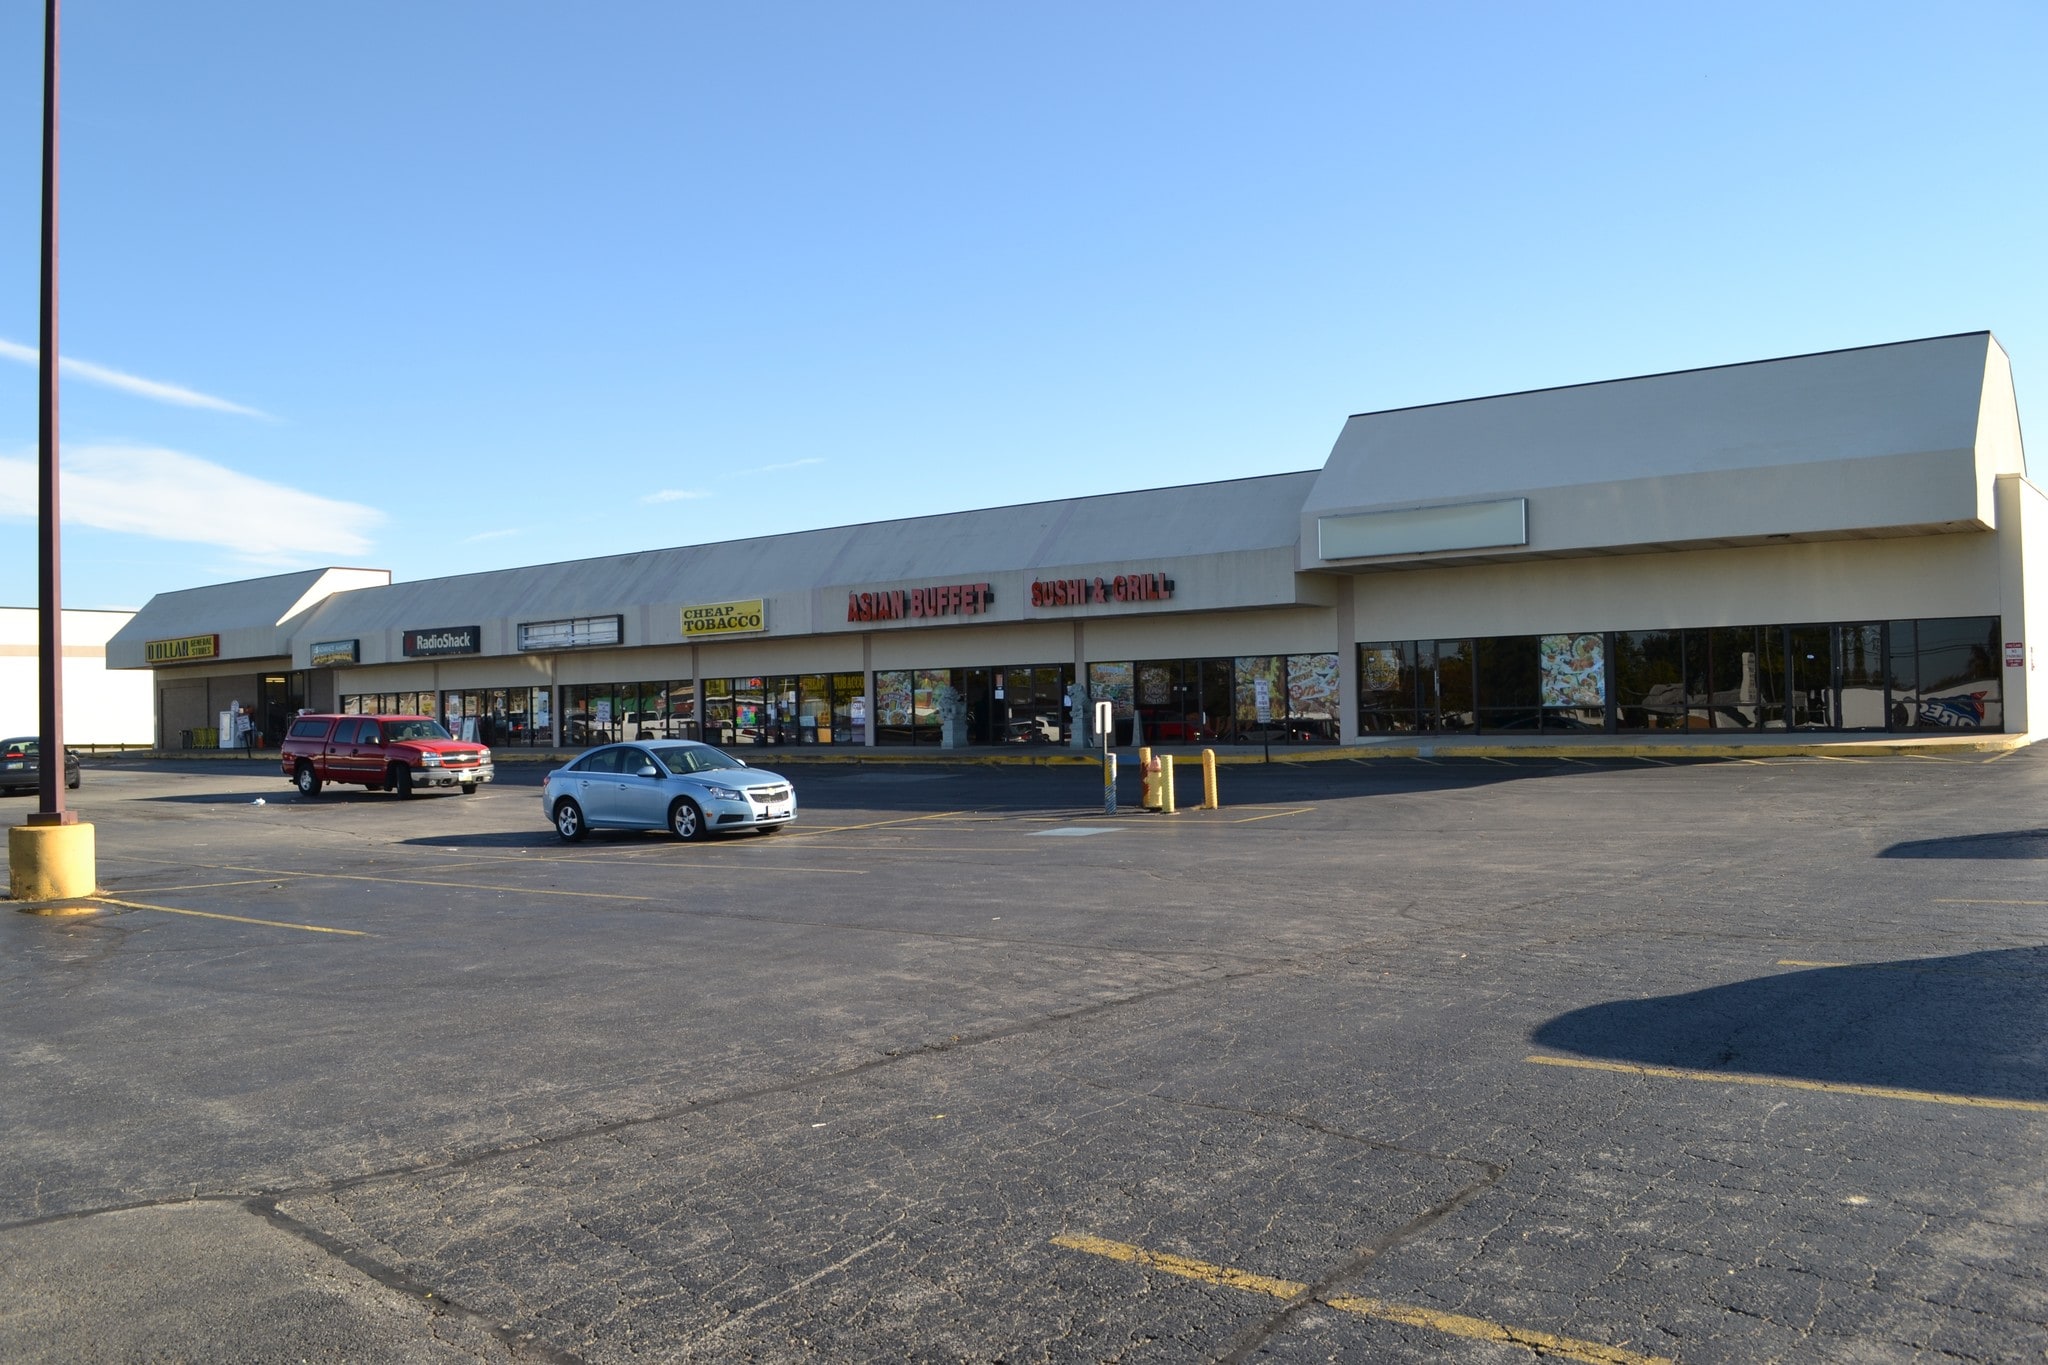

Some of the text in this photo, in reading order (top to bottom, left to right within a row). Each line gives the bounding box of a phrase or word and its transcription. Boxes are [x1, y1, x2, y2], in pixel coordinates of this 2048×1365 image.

[1031, 572, 1171, 607] SUSHI & GRILL
[847, 583, 990, 622] ASIAN BUFFET
[683, 606, 734, 619] CHEAP
[683, 614, 761, 632] TOBACCO
[190, 637, 212, 647] GENERAL
[416, 631, 471, 650] RadioShack
[147, 640, 189, 660] DOLLAR
[191, 646, 211, 656] STORES
